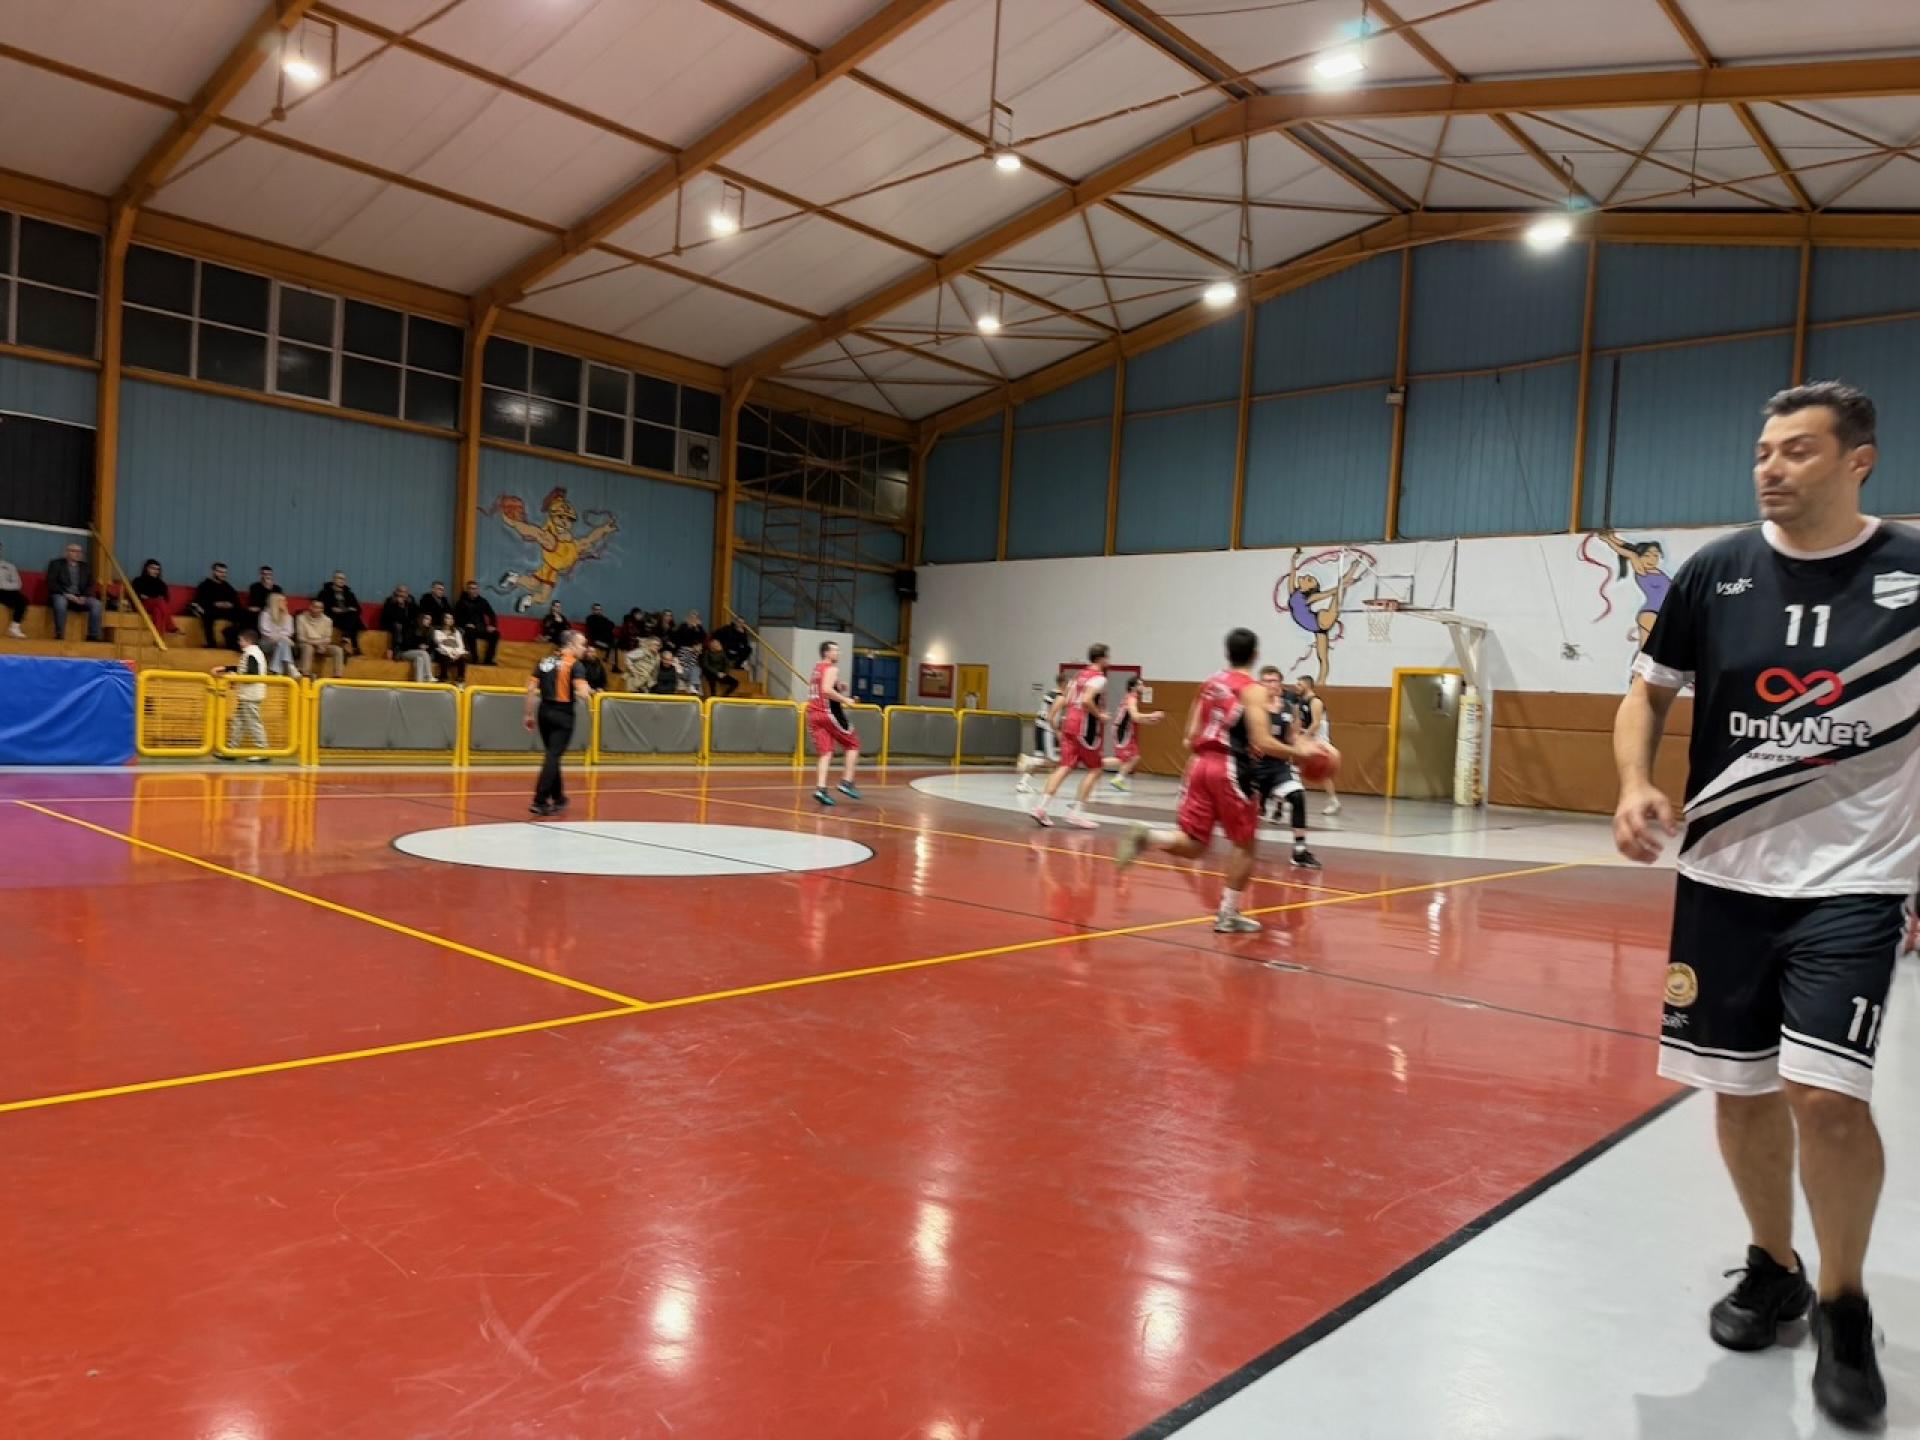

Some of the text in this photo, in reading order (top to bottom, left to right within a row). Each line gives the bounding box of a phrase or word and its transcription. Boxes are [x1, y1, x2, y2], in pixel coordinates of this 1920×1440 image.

[1785, 604, 1831, 647] 11
[1730, 711, 1870, 748] OnlyNet
[1847, 996, 1881, 1048] 11
